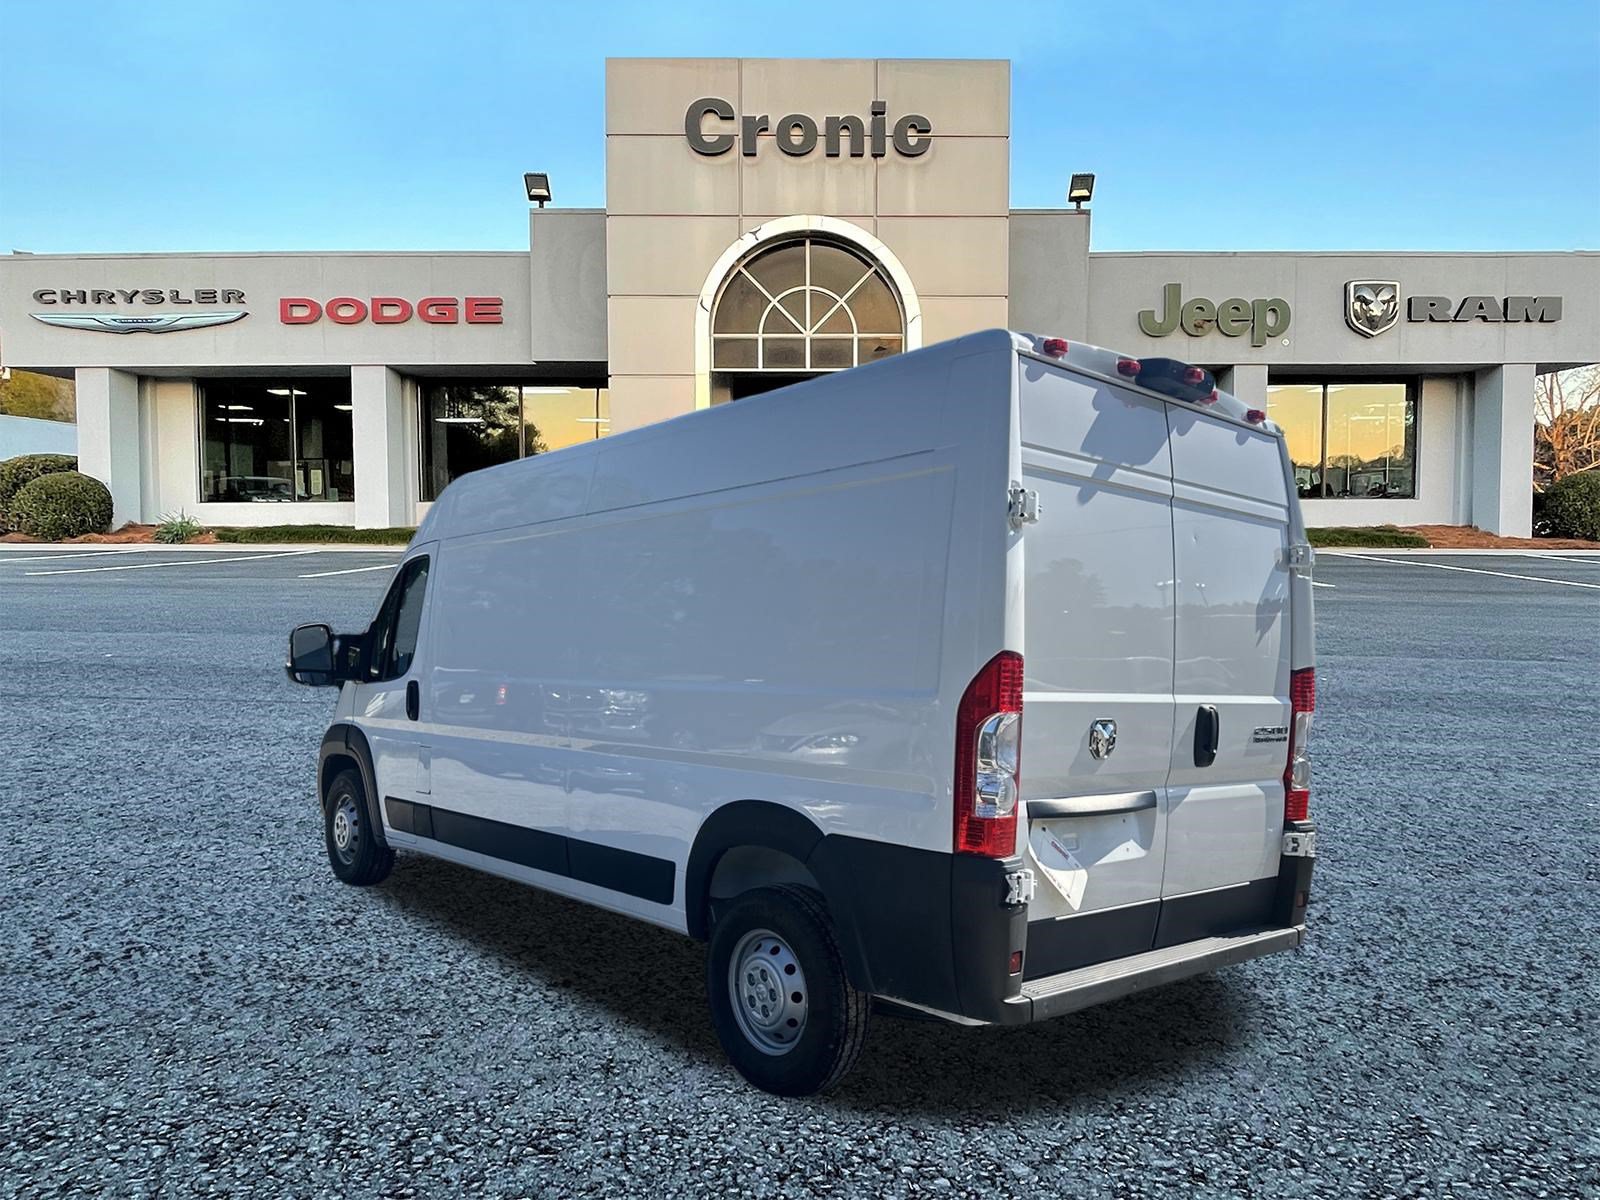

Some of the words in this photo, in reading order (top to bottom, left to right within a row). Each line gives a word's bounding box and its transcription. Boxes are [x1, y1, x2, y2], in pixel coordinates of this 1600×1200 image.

[684, 97, 932, 158] Cronic
[32, 289, 248, 305] CHRYSLER
[279, 296, 504, 324] DODGE
[1406, 295, 1563, 323] RAM
[1138, 282, 1292, 347] Jeep
